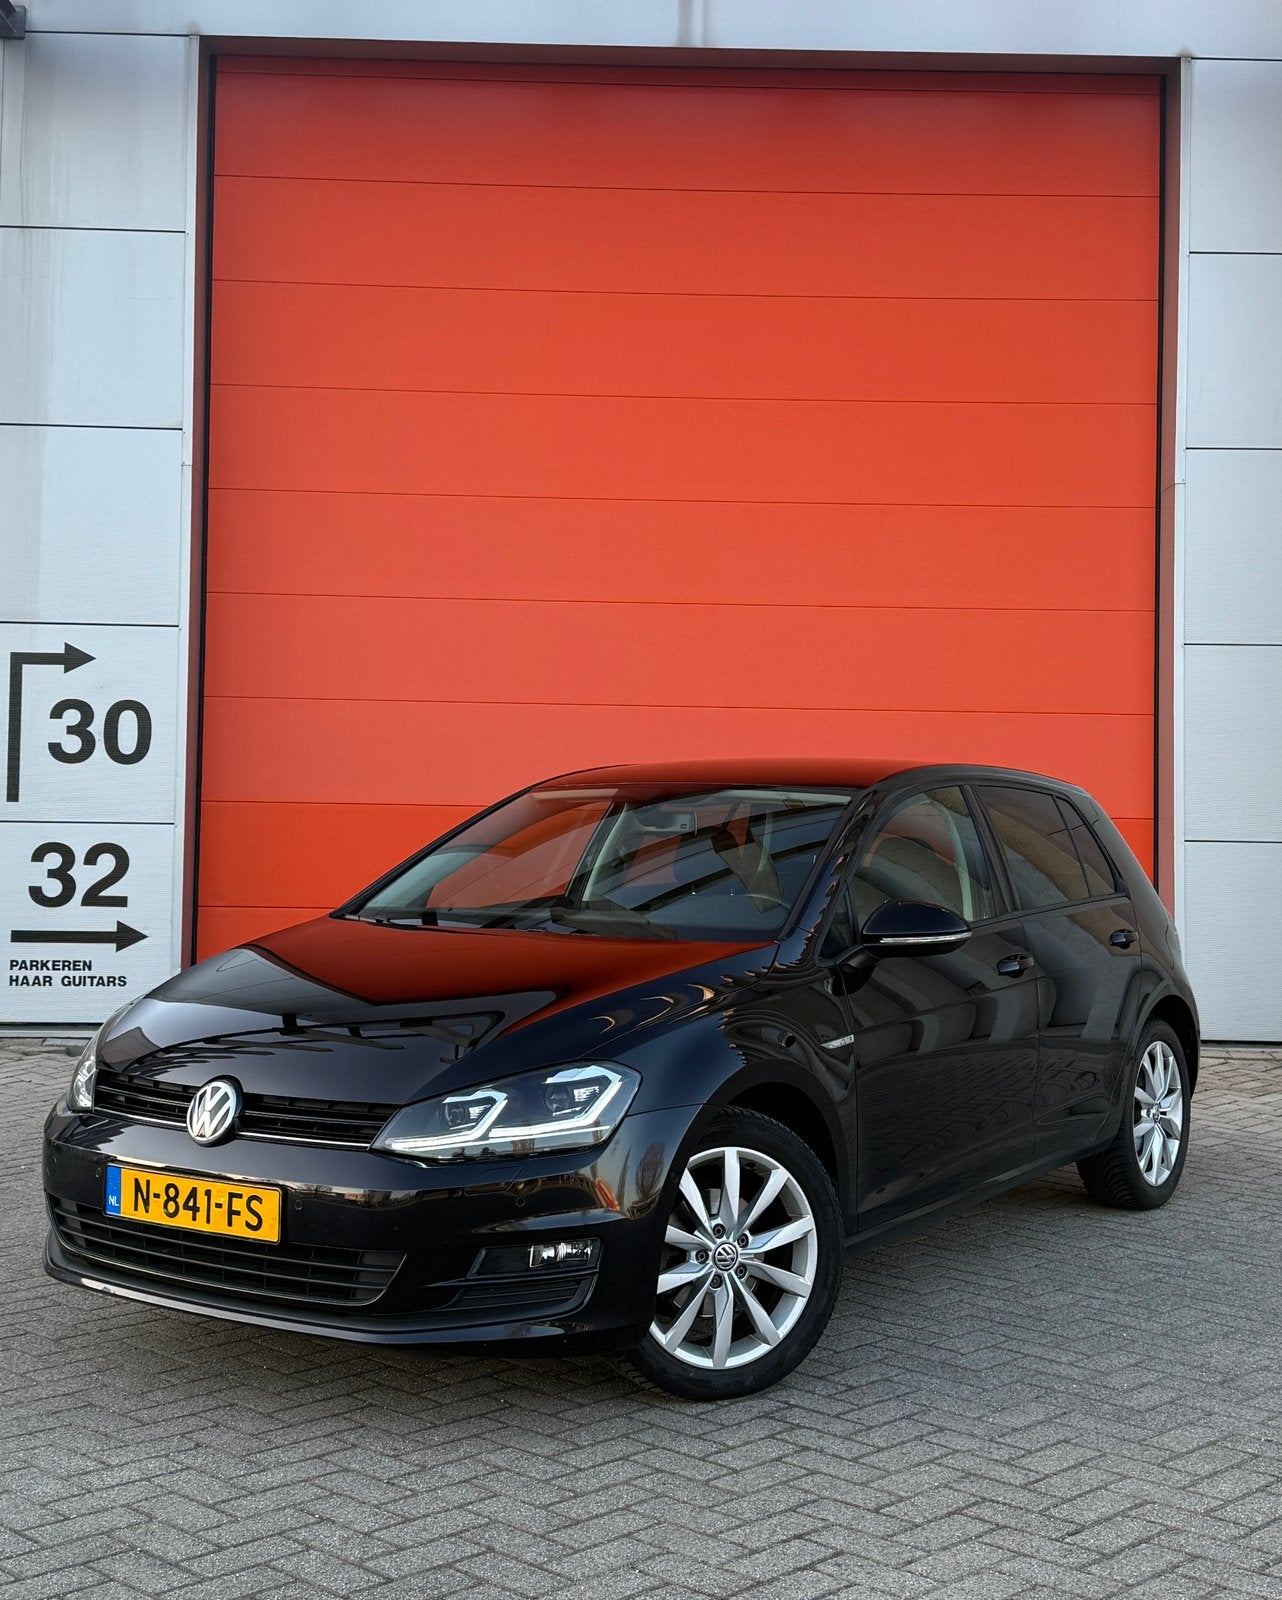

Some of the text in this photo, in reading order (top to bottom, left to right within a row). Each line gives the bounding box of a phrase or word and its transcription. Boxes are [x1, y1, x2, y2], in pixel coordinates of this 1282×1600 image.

[48, 698, 152, 765] 30
[28, 841, 130, 908] 32
[9, 959, 92, 971] PARKEREN
[9, 975, 127, 987] HAAR GUITARS
[108, 1194, 120, 1207] NL
[133, 1177, 264, 1232] N-841-FS
